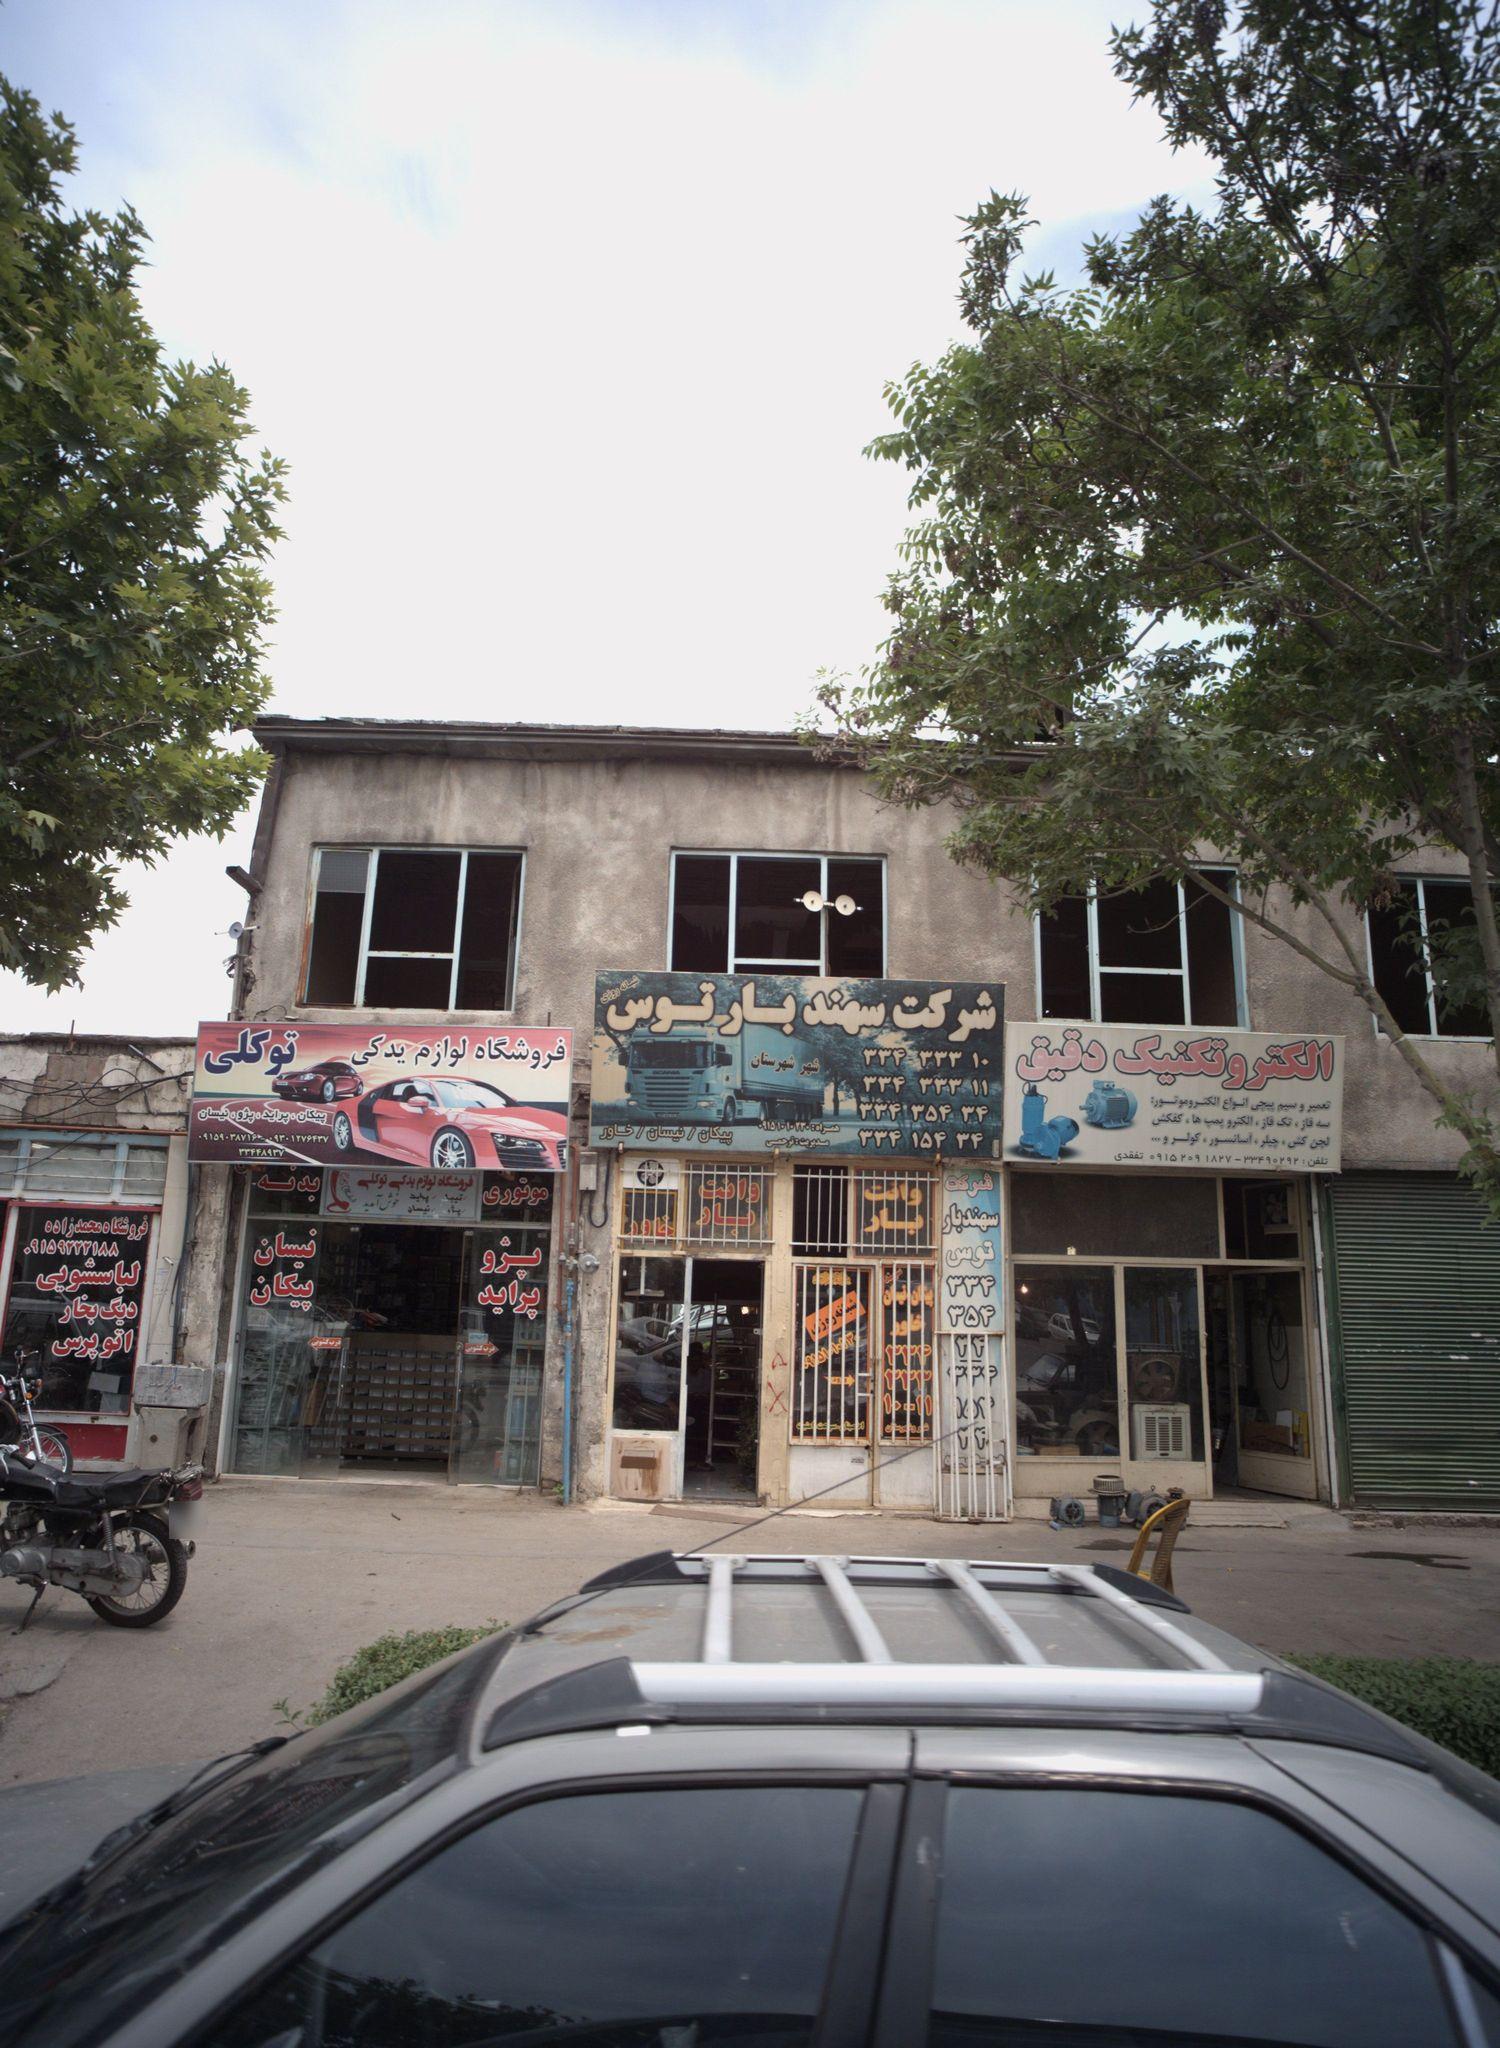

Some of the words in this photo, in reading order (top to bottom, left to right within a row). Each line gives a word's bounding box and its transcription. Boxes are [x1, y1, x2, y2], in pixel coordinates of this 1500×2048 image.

[606, 980, 716, 1034] توس
[718, 980, 797, 1037] بار
[802, 989, 887, 1036] سهند
[892, 987, 997, 1042] شرکت
[204, 1028, 300, 1077] توکلی
[351, 1035, 405, 1067] یدکی
[414, 1037, 467, 1069] لوازم
[474, 1036, 567, 1070] فروشگاه
[751, 1051, 795, 1073] شهرستان
[862, 1047, 906, 1067] ۳۳۴
[919, 1049, 963, 1068] ۳۳۳
[972, 1051, 990, 1069] ۱۰
[1016, 1028, 1107, 1082] دقیق
[1115, 1035, 1335, 1090] الکتروتکنیک
[799, 1057, 820, 1075] شهر
[862, 1075, 906, 1094] ۳۳۴
[919, 1077, 963, 1096] ۳۳۳
[971, 1079, 989, 1097] ۱۱
[197, 1107, 230, 1123] نیسان
[859, 1102, 902, 1121] ۳۳۴
[911, 1103, 953, 1122] ۳۵۴
[961, 1105, 989, 1123] ۳۴
[1222, 1097, 1249, 1110] انواع
[1277, 1101, 1297, 1112] سیم
[1307, 1099, 1331, 1113] تعمیر
[599, 1122, 634, 1141] خاور
[647, 1124, 684, 1141] نیسان
[698, 1126, 734, 1145] پیکان
[859, 1129, 902, 1149] ۳۳۴
[911, 1131, 948, 1150] ۱۵۴
[956, 1132, 984, 1150] ۳۴
[357, 1172, 388, 1190] توکلی
[388, 1174, 416, 1191] یدکی
[416, 1174, 437, 1191] لوازم
[438, 1171, 474, 1192] فروشگاه
[483, 1175, 549, 1206] موتوری
[944, 1173, 994, 1198] شرکت
[103, 1214, 148, 1240] فروشگاه
[696, 1202, 756, 1237] بار
[864, 1207, 924, 1236] بار
[253, 1227, 318, 1269] نیسان
[480, 1236, 543, 1280] پژو
[946, 1240, 995, 1269] توس
[36, 1257, 141, 1293] لباسشویی
[946, 1275, 996, 1297] ۳۳۴
[250, 1273, 314, 1312] پیکان
[478, 1279, 541, 1320] پراید
[58, 1294, 99, 1324] بخار
[100, 1296, 137, 1326] دیگ
[947, 1304, 996, 1328] ۳۵۴
[51, 1332, 99, 1359] پرس
[99, 1329, 134, 1358] اتو
